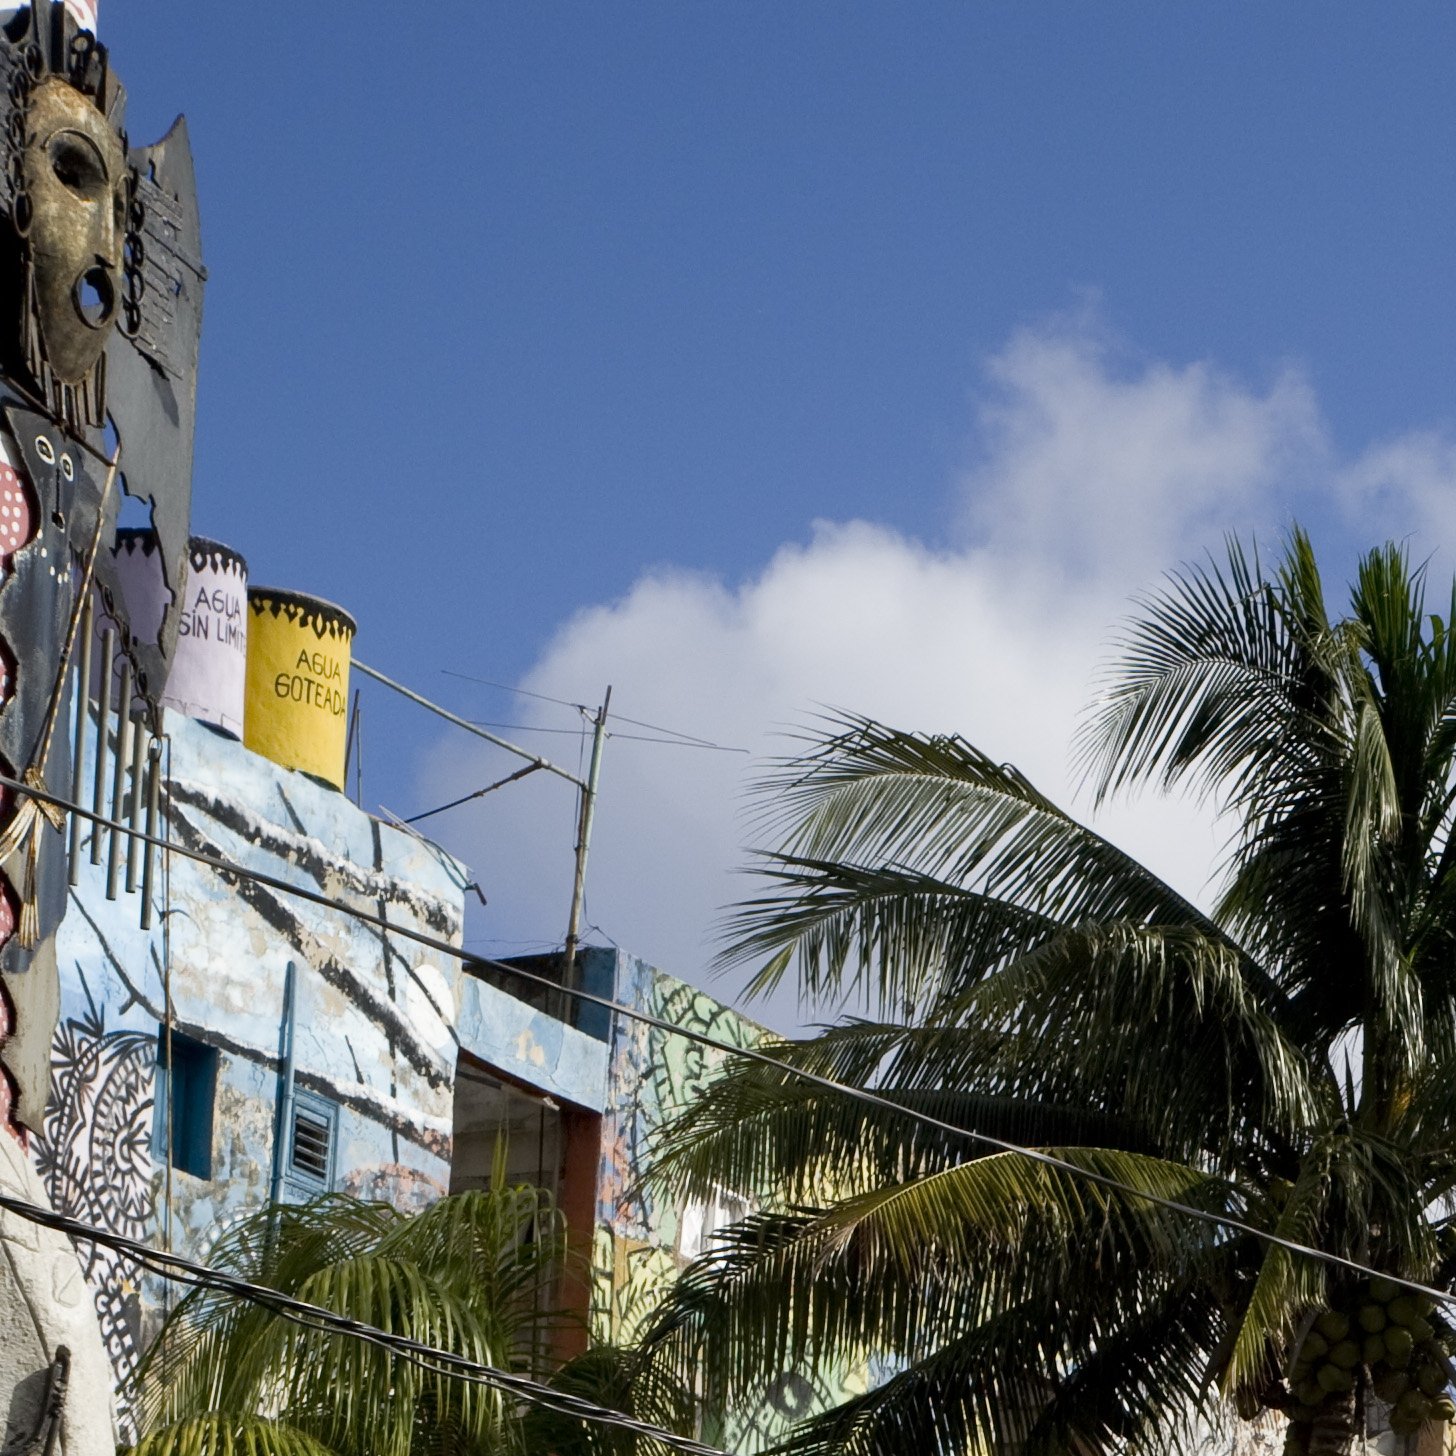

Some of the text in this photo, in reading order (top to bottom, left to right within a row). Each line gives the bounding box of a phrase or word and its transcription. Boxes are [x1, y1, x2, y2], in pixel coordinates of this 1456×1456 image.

[194, 586, 242, 622] AGUA
[295, 648, 343, 686] AGUA
[274, 672, 347, 720] GOTEADA
